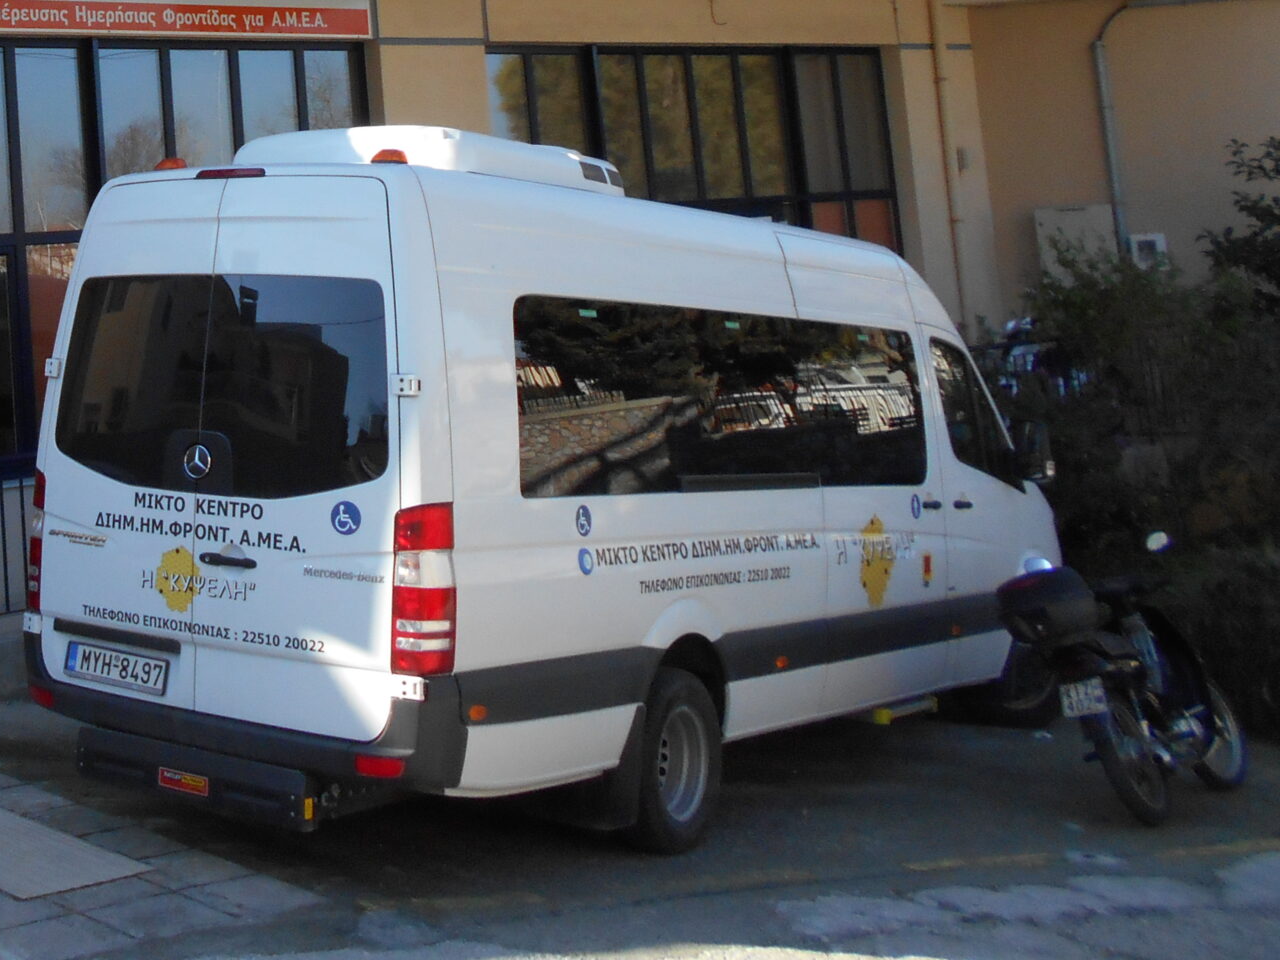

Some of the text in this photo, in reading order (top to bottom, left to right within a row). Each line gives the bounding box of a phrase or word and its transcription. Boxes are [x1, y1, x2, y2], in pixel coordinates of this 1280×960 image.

[75, 4, 157, 27] Ημερήσιας
[162, 8, 236, 29] Φροντίδας
[242, 10, 265, 28] για
[133, 491, 264, 520] ΜΙΚΤΟ ΚΕΝΤΡΟ
[595, 545, 639, 567] ΜΙΚΤΟ
[641, 542, 689, 563] ΚΕΝΤΡΟ
[640, 575, 684, 594] ΤΗΛΕΦΩΝΟ
[685, 570, 742, 590] ΕΠΙΚΟΙΝΩΝΙΑΣ
[747, 568, 769, 582] 22510
[770, 566, 791, 581] 20022
[82, 604, 140, 625] ΤΗΛΕΦΩΝΟ
[143, 614, 231, 640] ΕΠΙΚΟΙΝΩΝΙΑΣ
[242, 631, 280, 647] 22510
[284, 636, 325, 653] 20022
